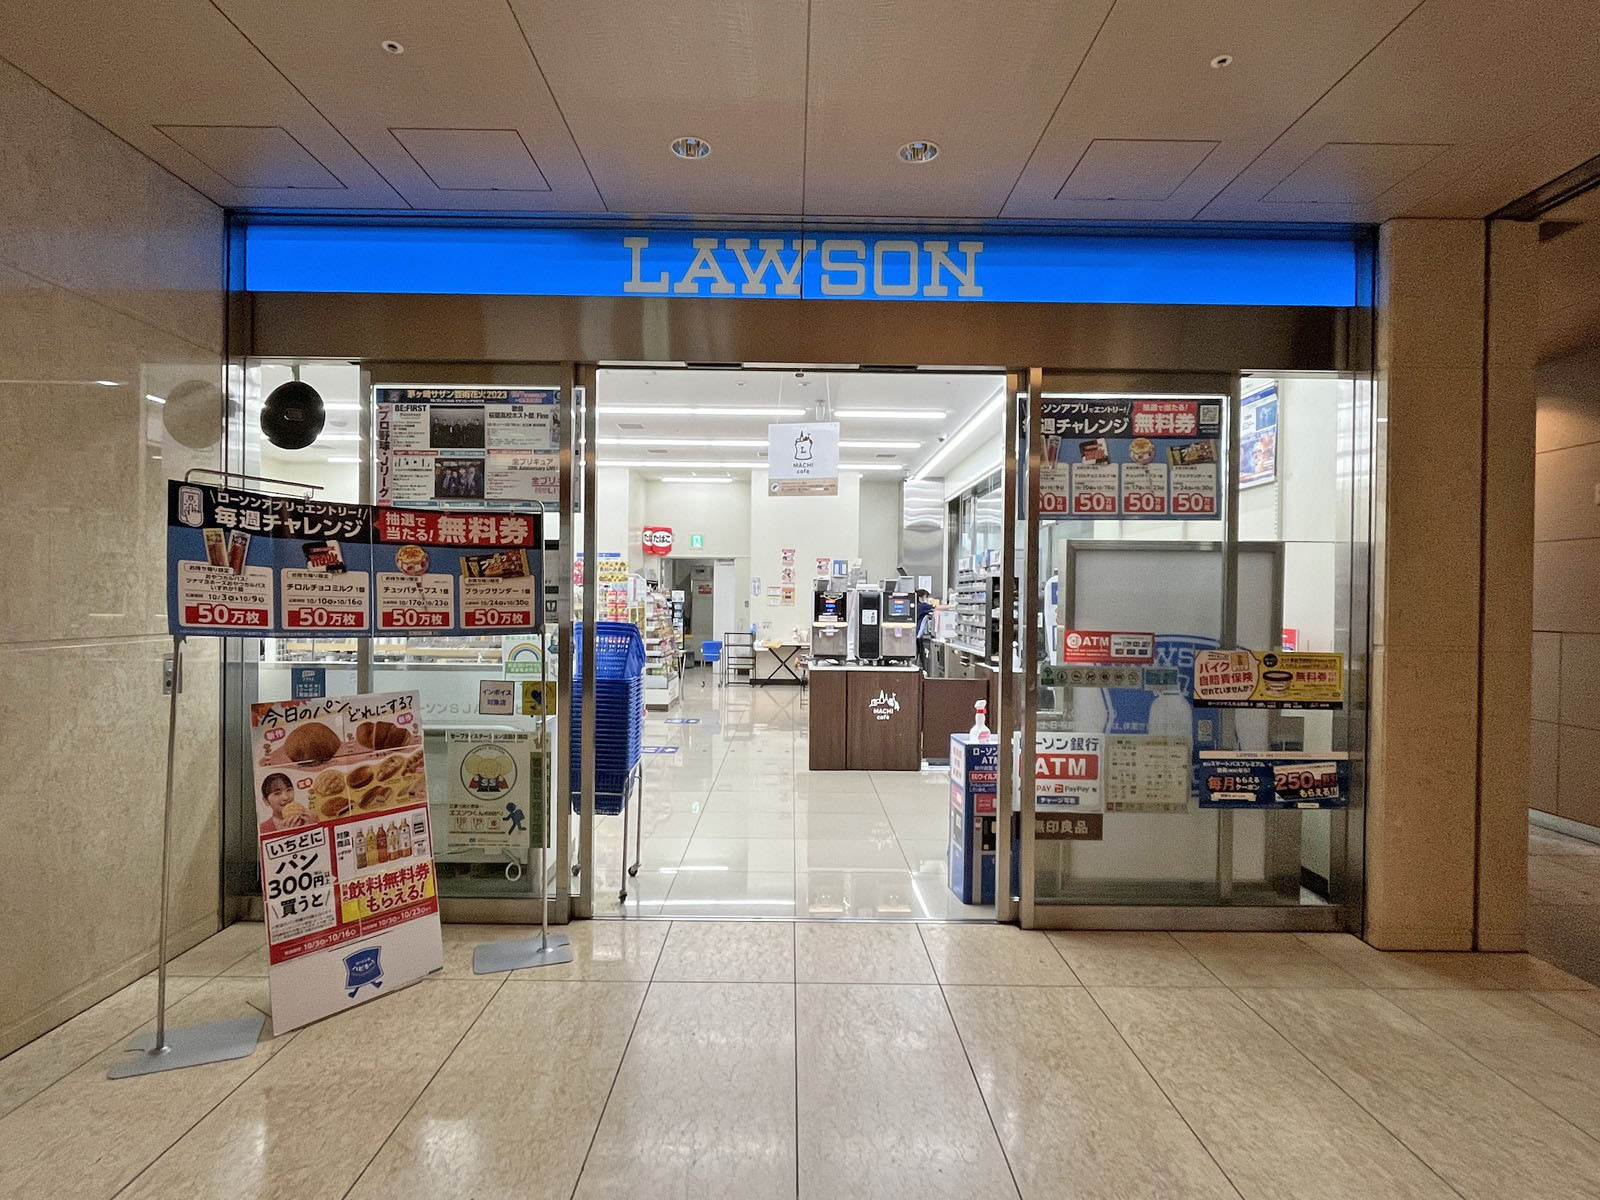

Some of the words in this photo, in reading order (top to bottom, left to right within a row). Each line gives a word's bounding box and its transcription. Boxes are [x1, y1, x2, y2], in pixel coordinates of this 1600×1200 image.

[623, 237, 984, 296] LAWSON
[1041, 402, 1128, 414] ソンアプリでエントリー!
[1135, 413, 1196, 434] 無料券
[218, 492, 363, 518] ローソンアプリでエントリー!
[1080, 493, 1105, 511] 50
[1129, 493, 1155, 511] 50
[1178, 493, 1204, 511] 50
[215, 506, 362, 538] 毎週チャレンジ
[386, 512, 426, 526] 抽選で
[386, 527, 433, 542] 当たる!
[437, 516, 528, 544] 無料券
[653, 534, 671, 543] たばこ
[286, 583, 353, 592] チロルチョコミルク
[383, 586, 437, 595] チュッパチャプス
[465, 587, 519, 595] ブラックサンダー
[197, 604, 260, 625] 50万枚
[300, 608, 356, 626] 50万枚
[392, 609, 443, 626] 50万枚
[474, 609, 523, 626] 50万枚
[1082, 636, 1110, 647] ATM
[1199, 661, 1230, 673] バイク
[1199, 672, 1254, 686] 自賠責保険
[1296, 671, 1327, 682] 無料券
[1201, 685, 1255, 695] 切れていませんか?
[261, 699, 350, 728] 今日のパン
[349, 695, 414, 722] どれにする?
[1036, 738, 1099, 751] ーソン銀行
[1036, 757, 1086, 776] ATM
[1207, 775, 1236, 791] 毎月
[1299, 787, 1337, 798] もらえる!!
[270, 832, 323, 856] いちどに
[275, 853, 319, 874] パン
[268, 872, 324, 899] 300円
[348, 862, 430, 900] 飲料無料券
[367, 881, 425, 912] もらえる!
[281, 894, 324, 919] 買うと
